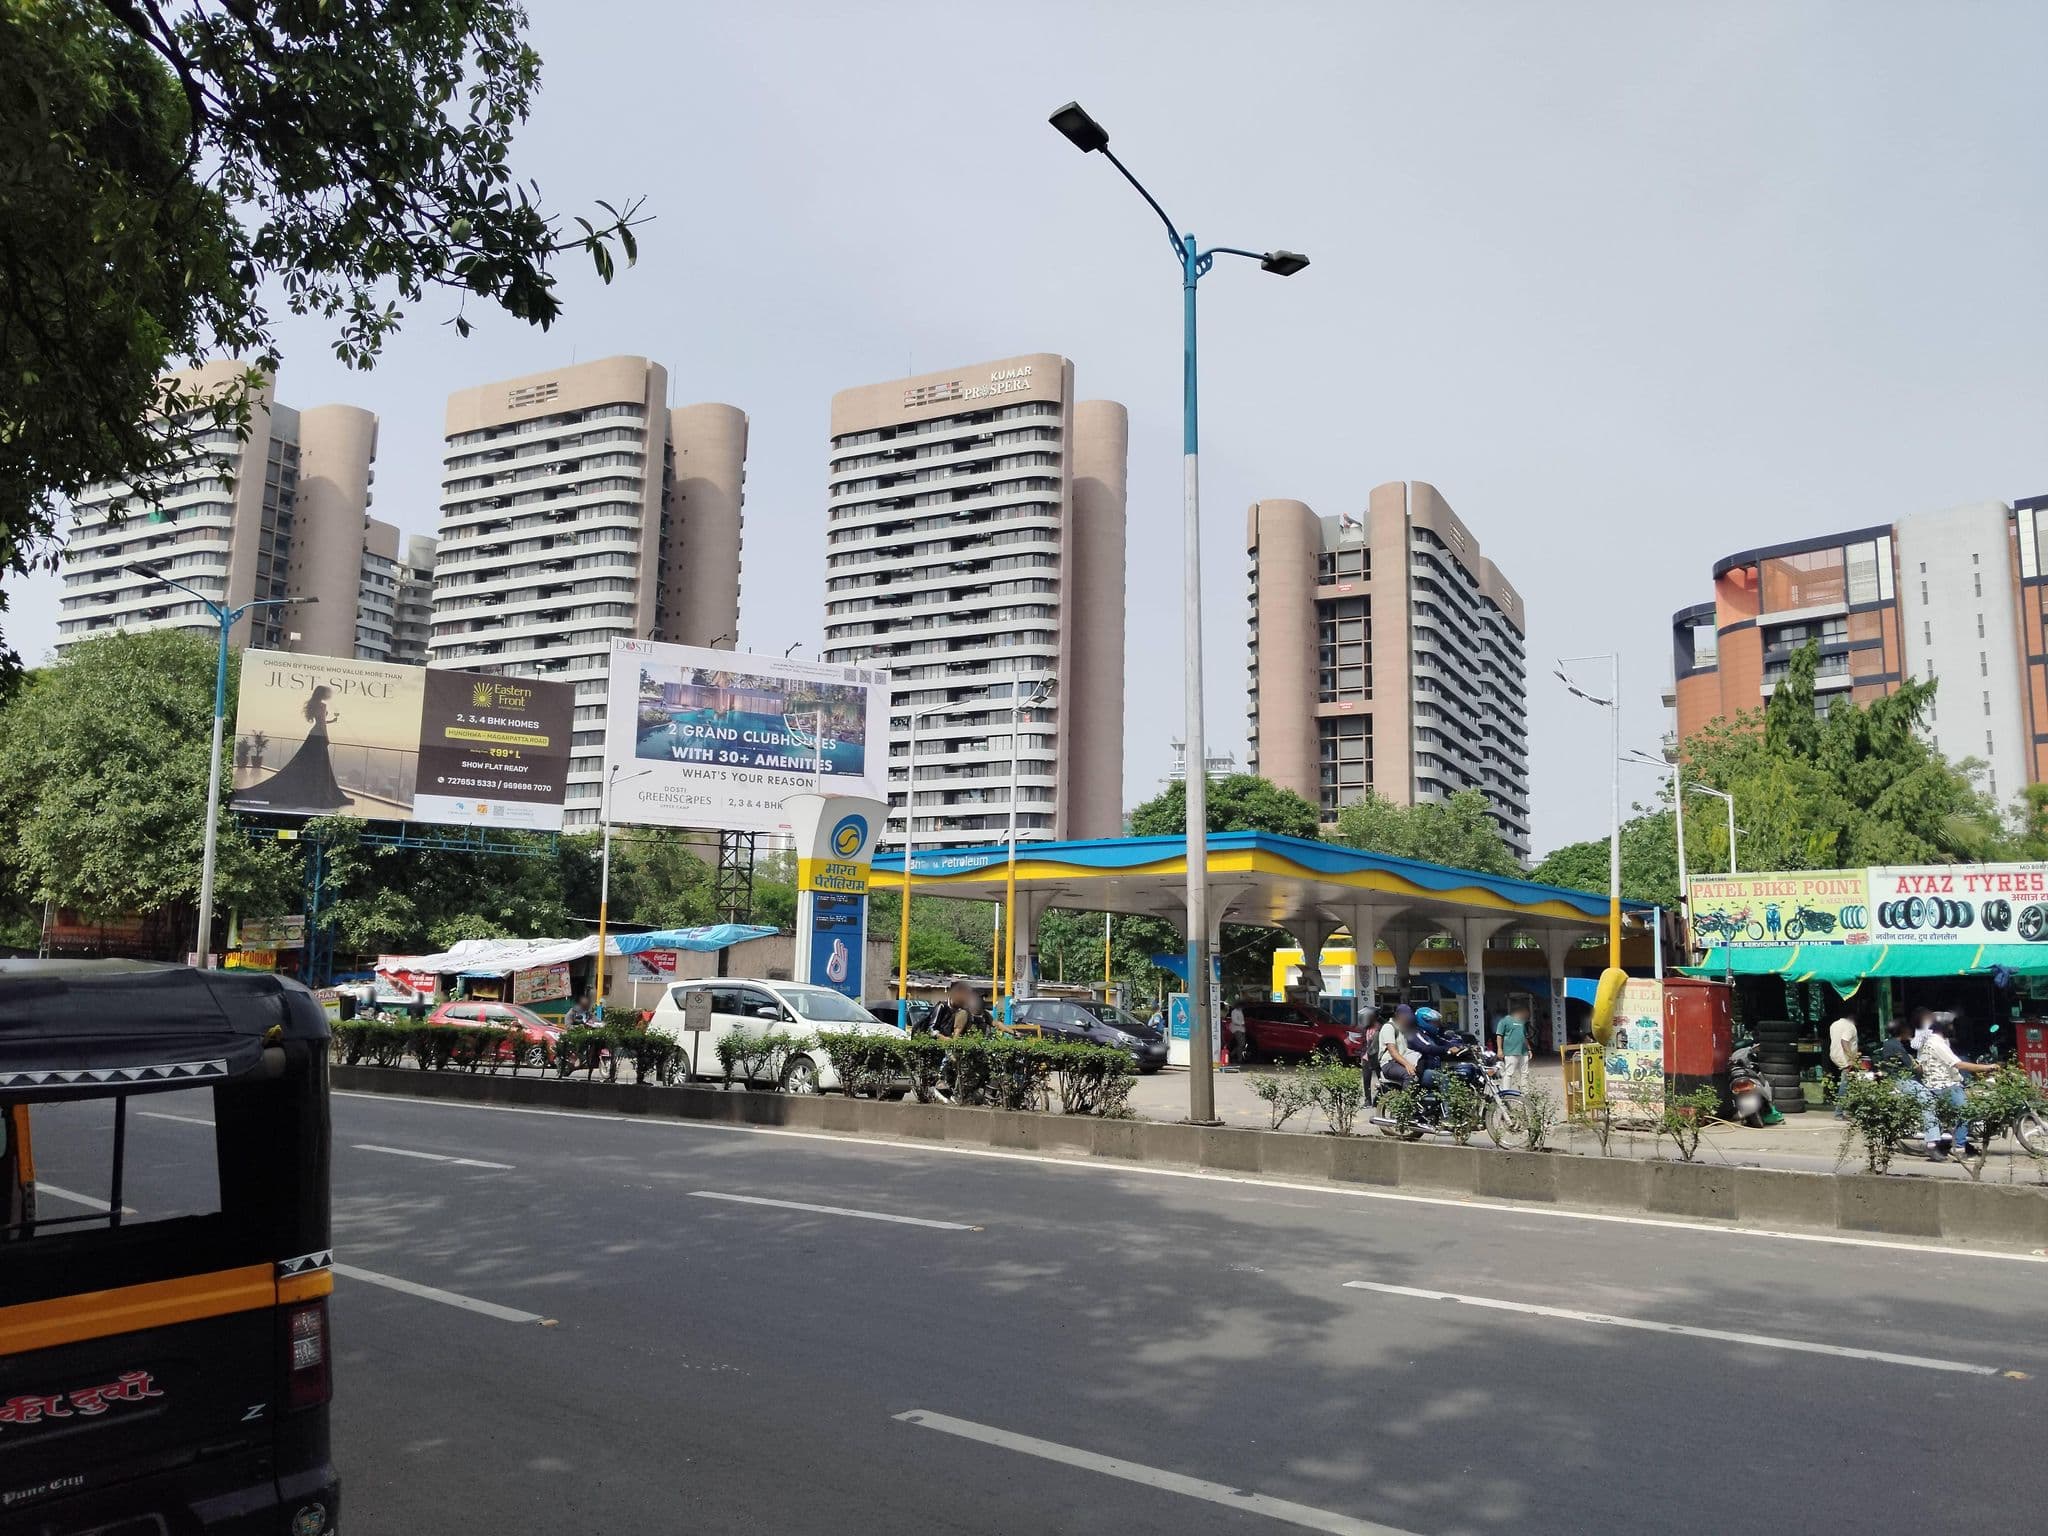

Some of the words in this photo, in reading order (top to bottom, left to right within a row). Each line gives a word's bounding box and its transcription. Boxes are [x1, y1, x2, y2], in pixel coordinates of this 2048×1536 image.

[991, 366, 1032, 382] KUMAR
[964, 379, 1031, 400] PROSPERA
[263, 659, 292, 668] CHOSEN
[264, 671, 320, 690] JUST
[329, 678, 394, 699] SPACE
[495, 683, 531, 697] Eastern
[498, 695, 525, 707] Front
[457, 713, 465, 722] 2,
[468, 715, 477, 723] 3,
[487, 716, 506, 726] BHK
[507, 718, 540, 729] HOMES
[668, 724, 676, 735] 2
[683, 724, 738, 741] GRAND
[529, 736, 547, 745] ROAD
[672, 745, 713, 761] WITH
[719, 750, 749, 764] 30+
[755, 753, 833, 771] AMENITIES
[461, 761, 483, 769] SHOW
[484, 763, 503, 771] FLAT
[504, 764, 529, 773] READY
[682, 768, 726, 781] WHAT'S
[732, 772, 763, 784] YOUR
[767, 777, 817, 788] REASON
[533, 784, 552, 792] 7070
[638, 791, 712, 805] GREENSCAPES
[728, 799, 737, 807] 2,
[738, 799, 744, 807] 3
[825, 863, 857, 876] भारत
[1692, 882, 1747, 899] PATEL
[1753, 881, 1797, 896] BIKE
[1803, 880, 1862, 895] POINT
[1896, 875, 1953, 894] AYAZ
[1964, 873, 2044, 893] TYRES
[2011, 893, 2038, 901] अयाज
[2, 1485, 46, 1505] Pune
[50, 1474, 84, 1490] City
